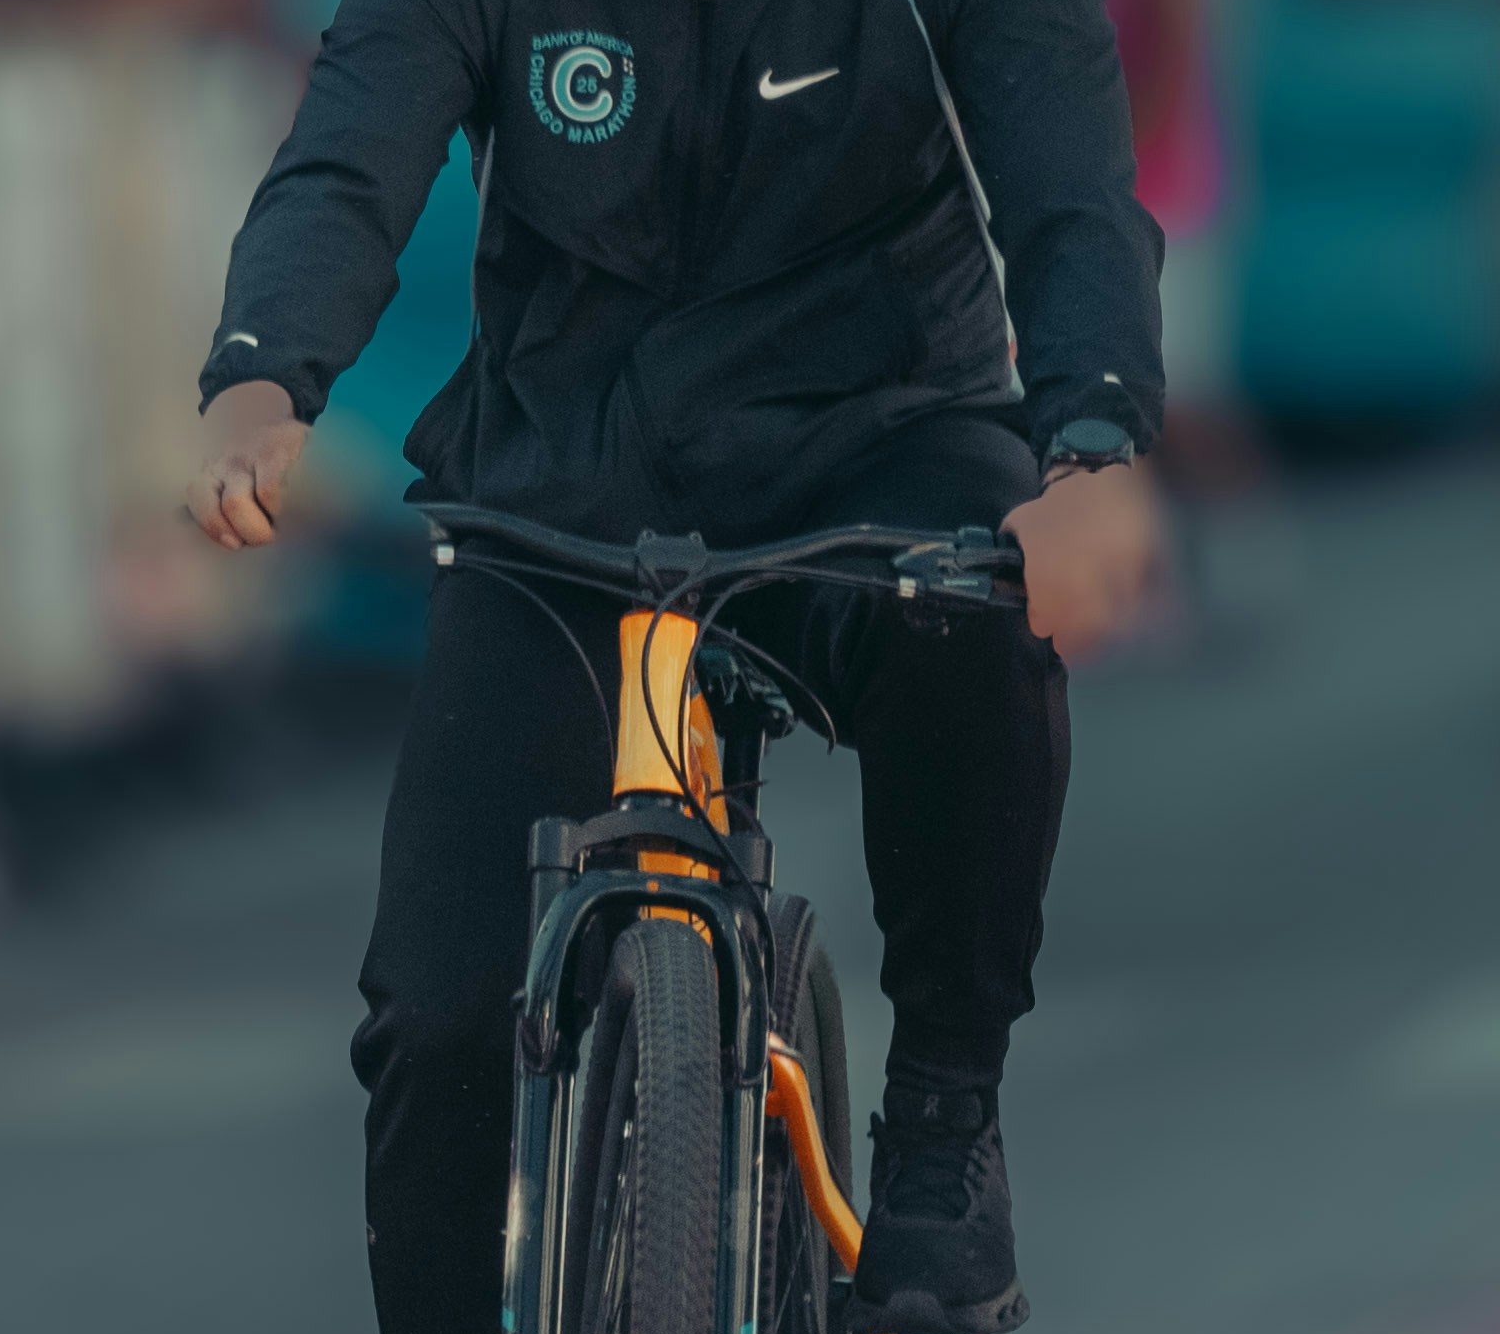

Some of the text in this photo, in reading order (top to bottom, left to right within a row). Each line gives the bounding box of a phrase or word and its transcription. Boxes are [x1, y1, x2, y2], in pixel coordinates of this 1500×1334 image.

[532, 30, 634, 58] BANK OF AMERICA
[529, 53, 564, 135] CHICAGO
[567, 75, 636, 144] MARATHON
